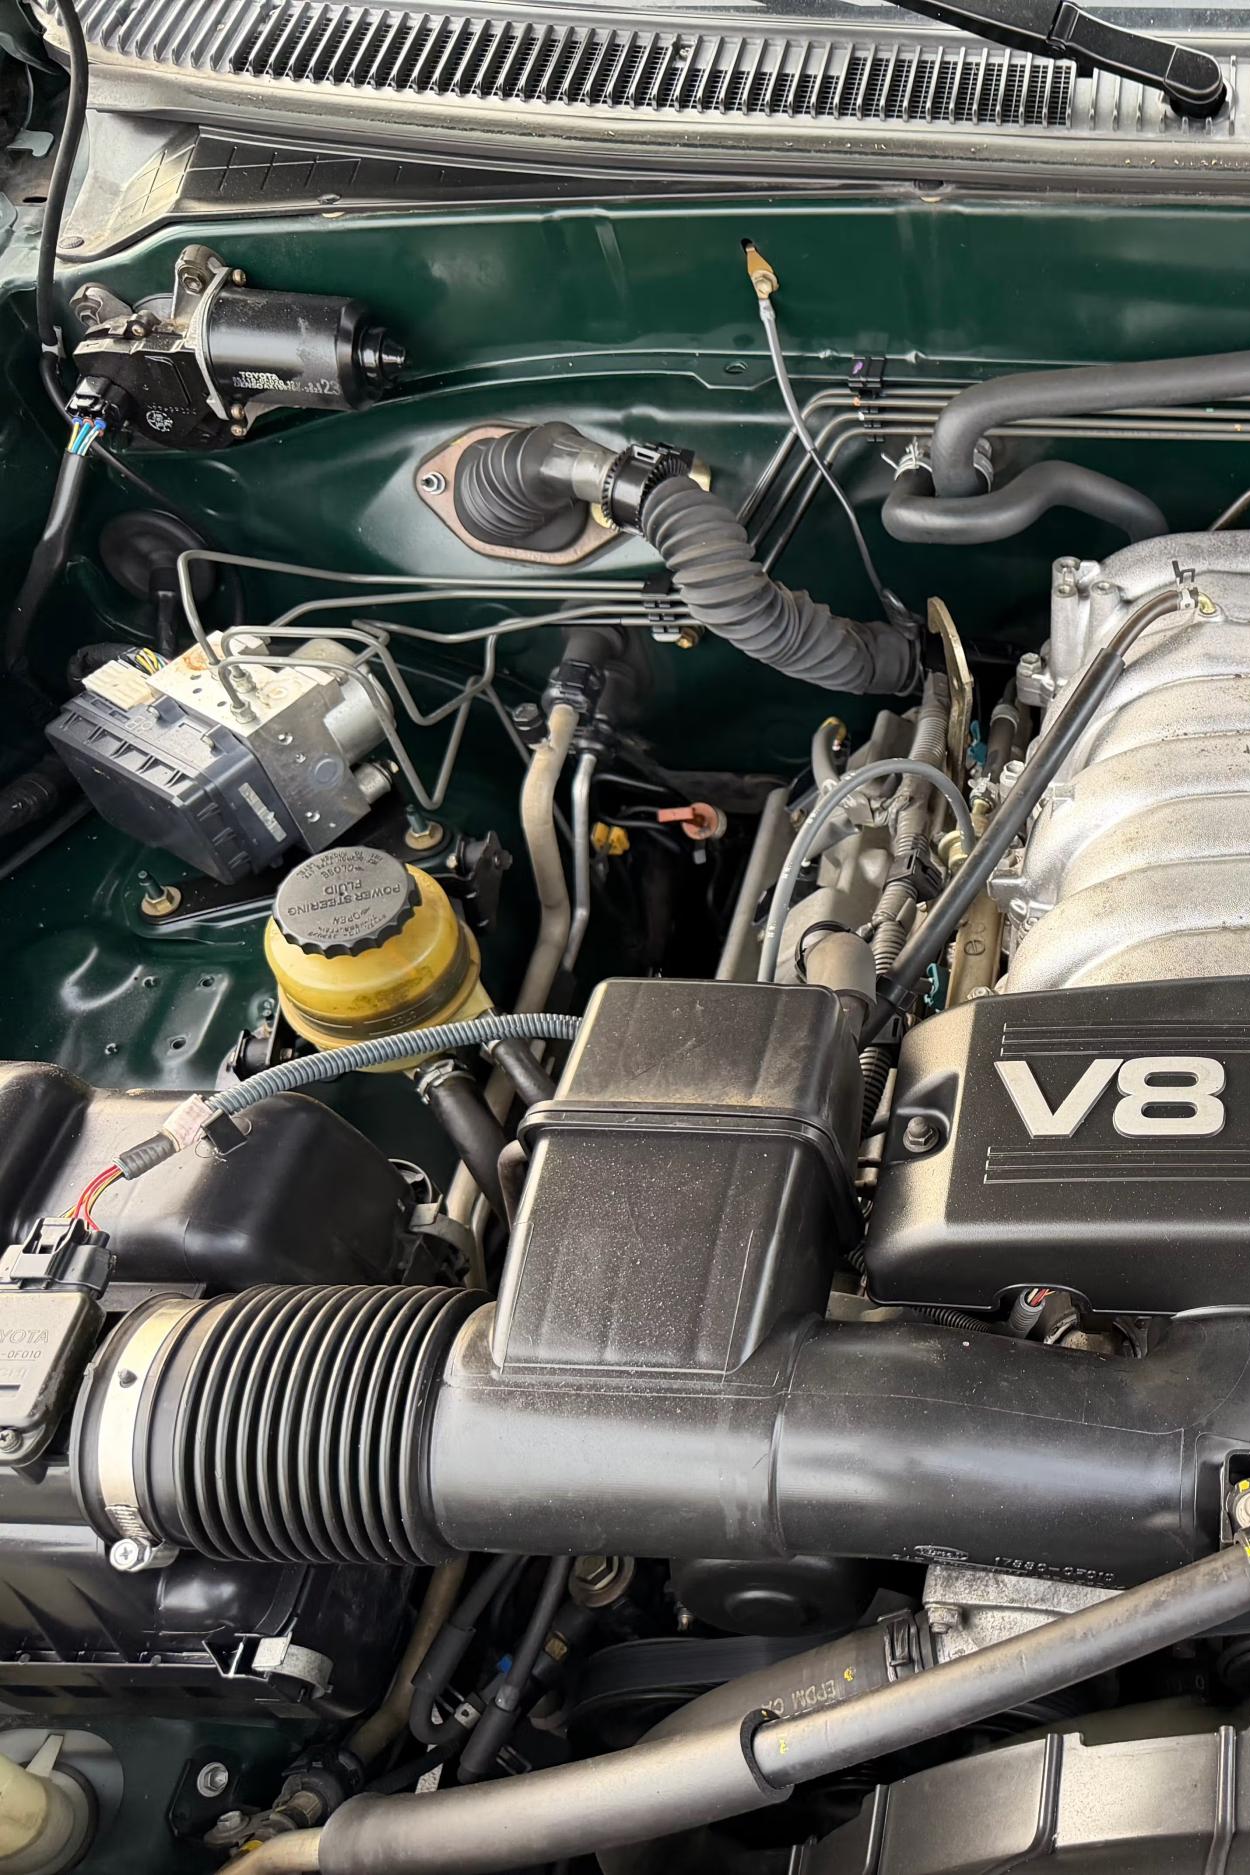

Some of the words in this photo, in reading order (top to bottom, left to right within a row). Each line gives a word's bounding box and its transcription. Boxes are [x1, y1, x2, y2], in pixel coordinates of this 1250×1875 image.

[322, 864, 355, 880] CLOSE
[324, 879, 363, 896] FLUID
[355, 884, 401, 901] POWER
[287, 894, 352, 917] STEERING
[332, 912, 361, 926] OPEN
[994, 1056, 1226, 1140] V8
[791, 1679, 836, 1711] EPDM
